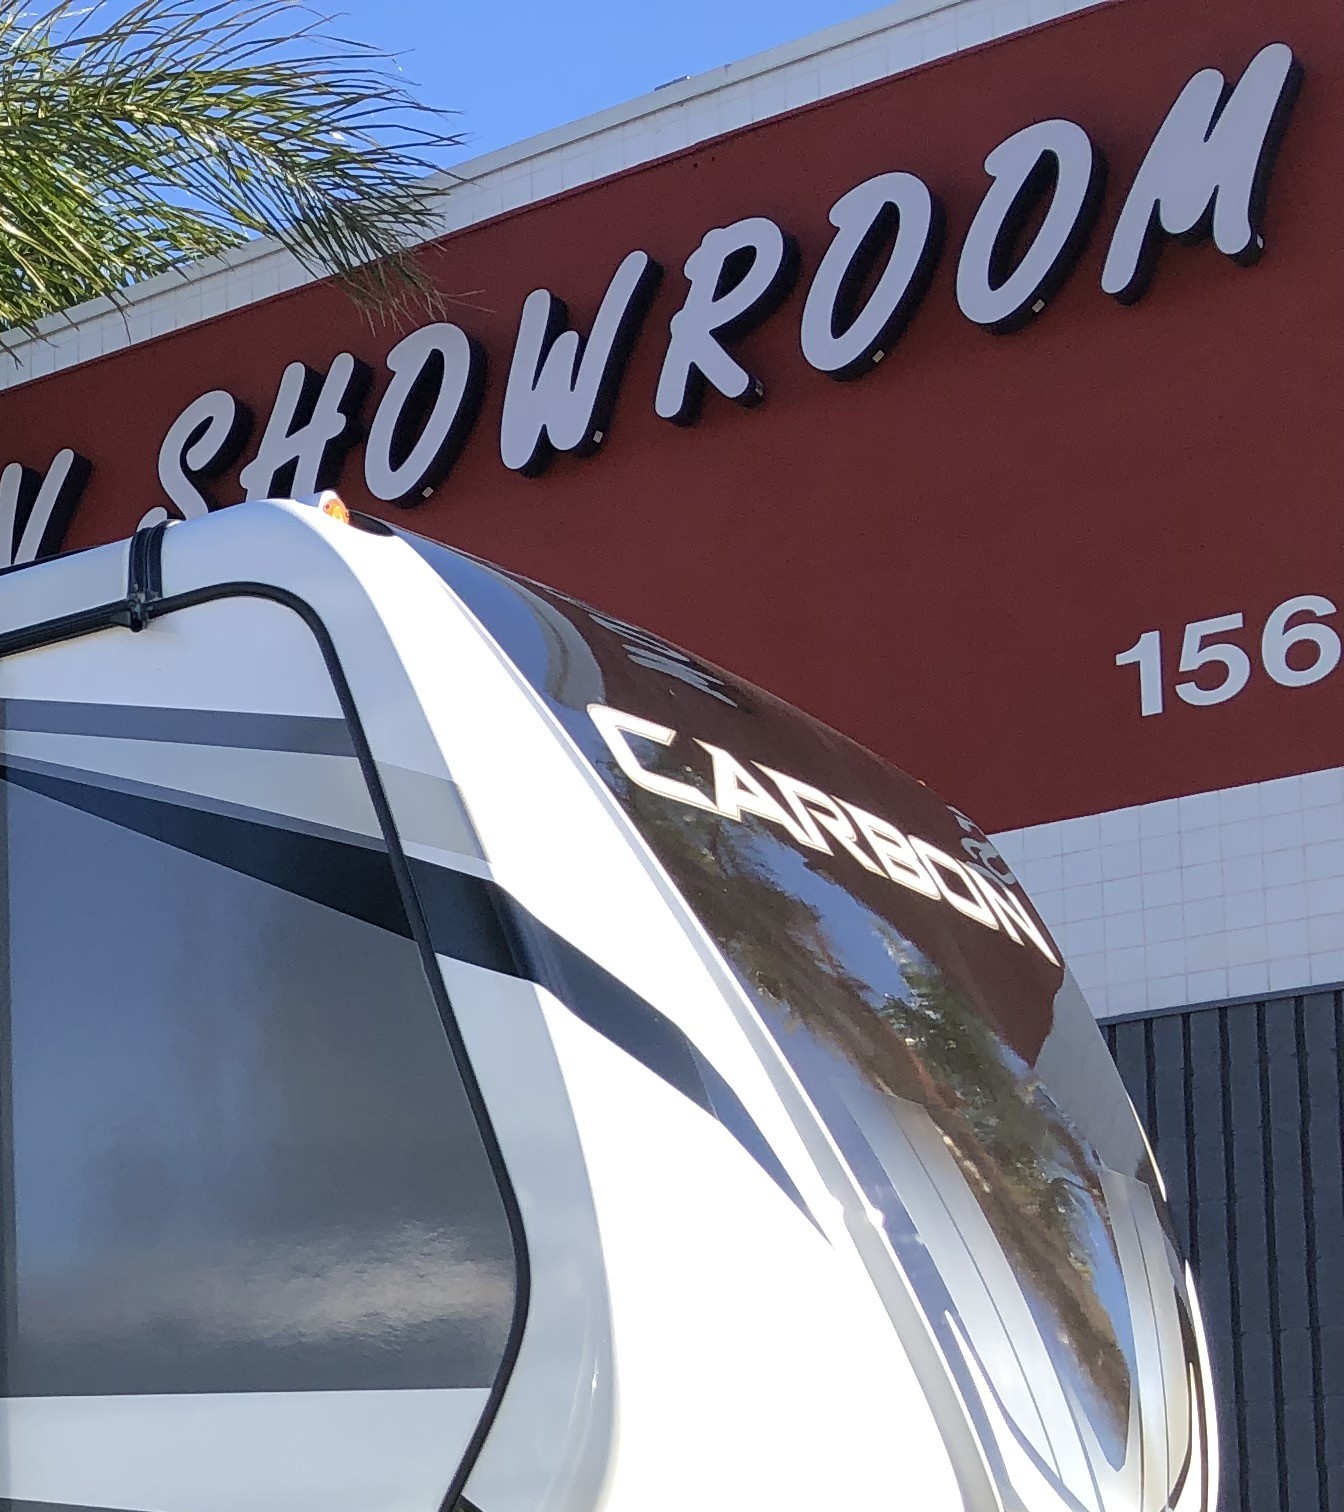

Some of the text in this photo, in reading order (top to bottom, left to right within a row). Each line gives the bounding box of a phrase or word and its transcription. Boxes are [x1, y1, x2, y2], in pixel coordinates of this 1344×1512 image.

[138, 42, 1296, 531] SHOWROOM
[1115, 595, 1342, 717] 156
[586, 703, 1060, 968] CARBON
